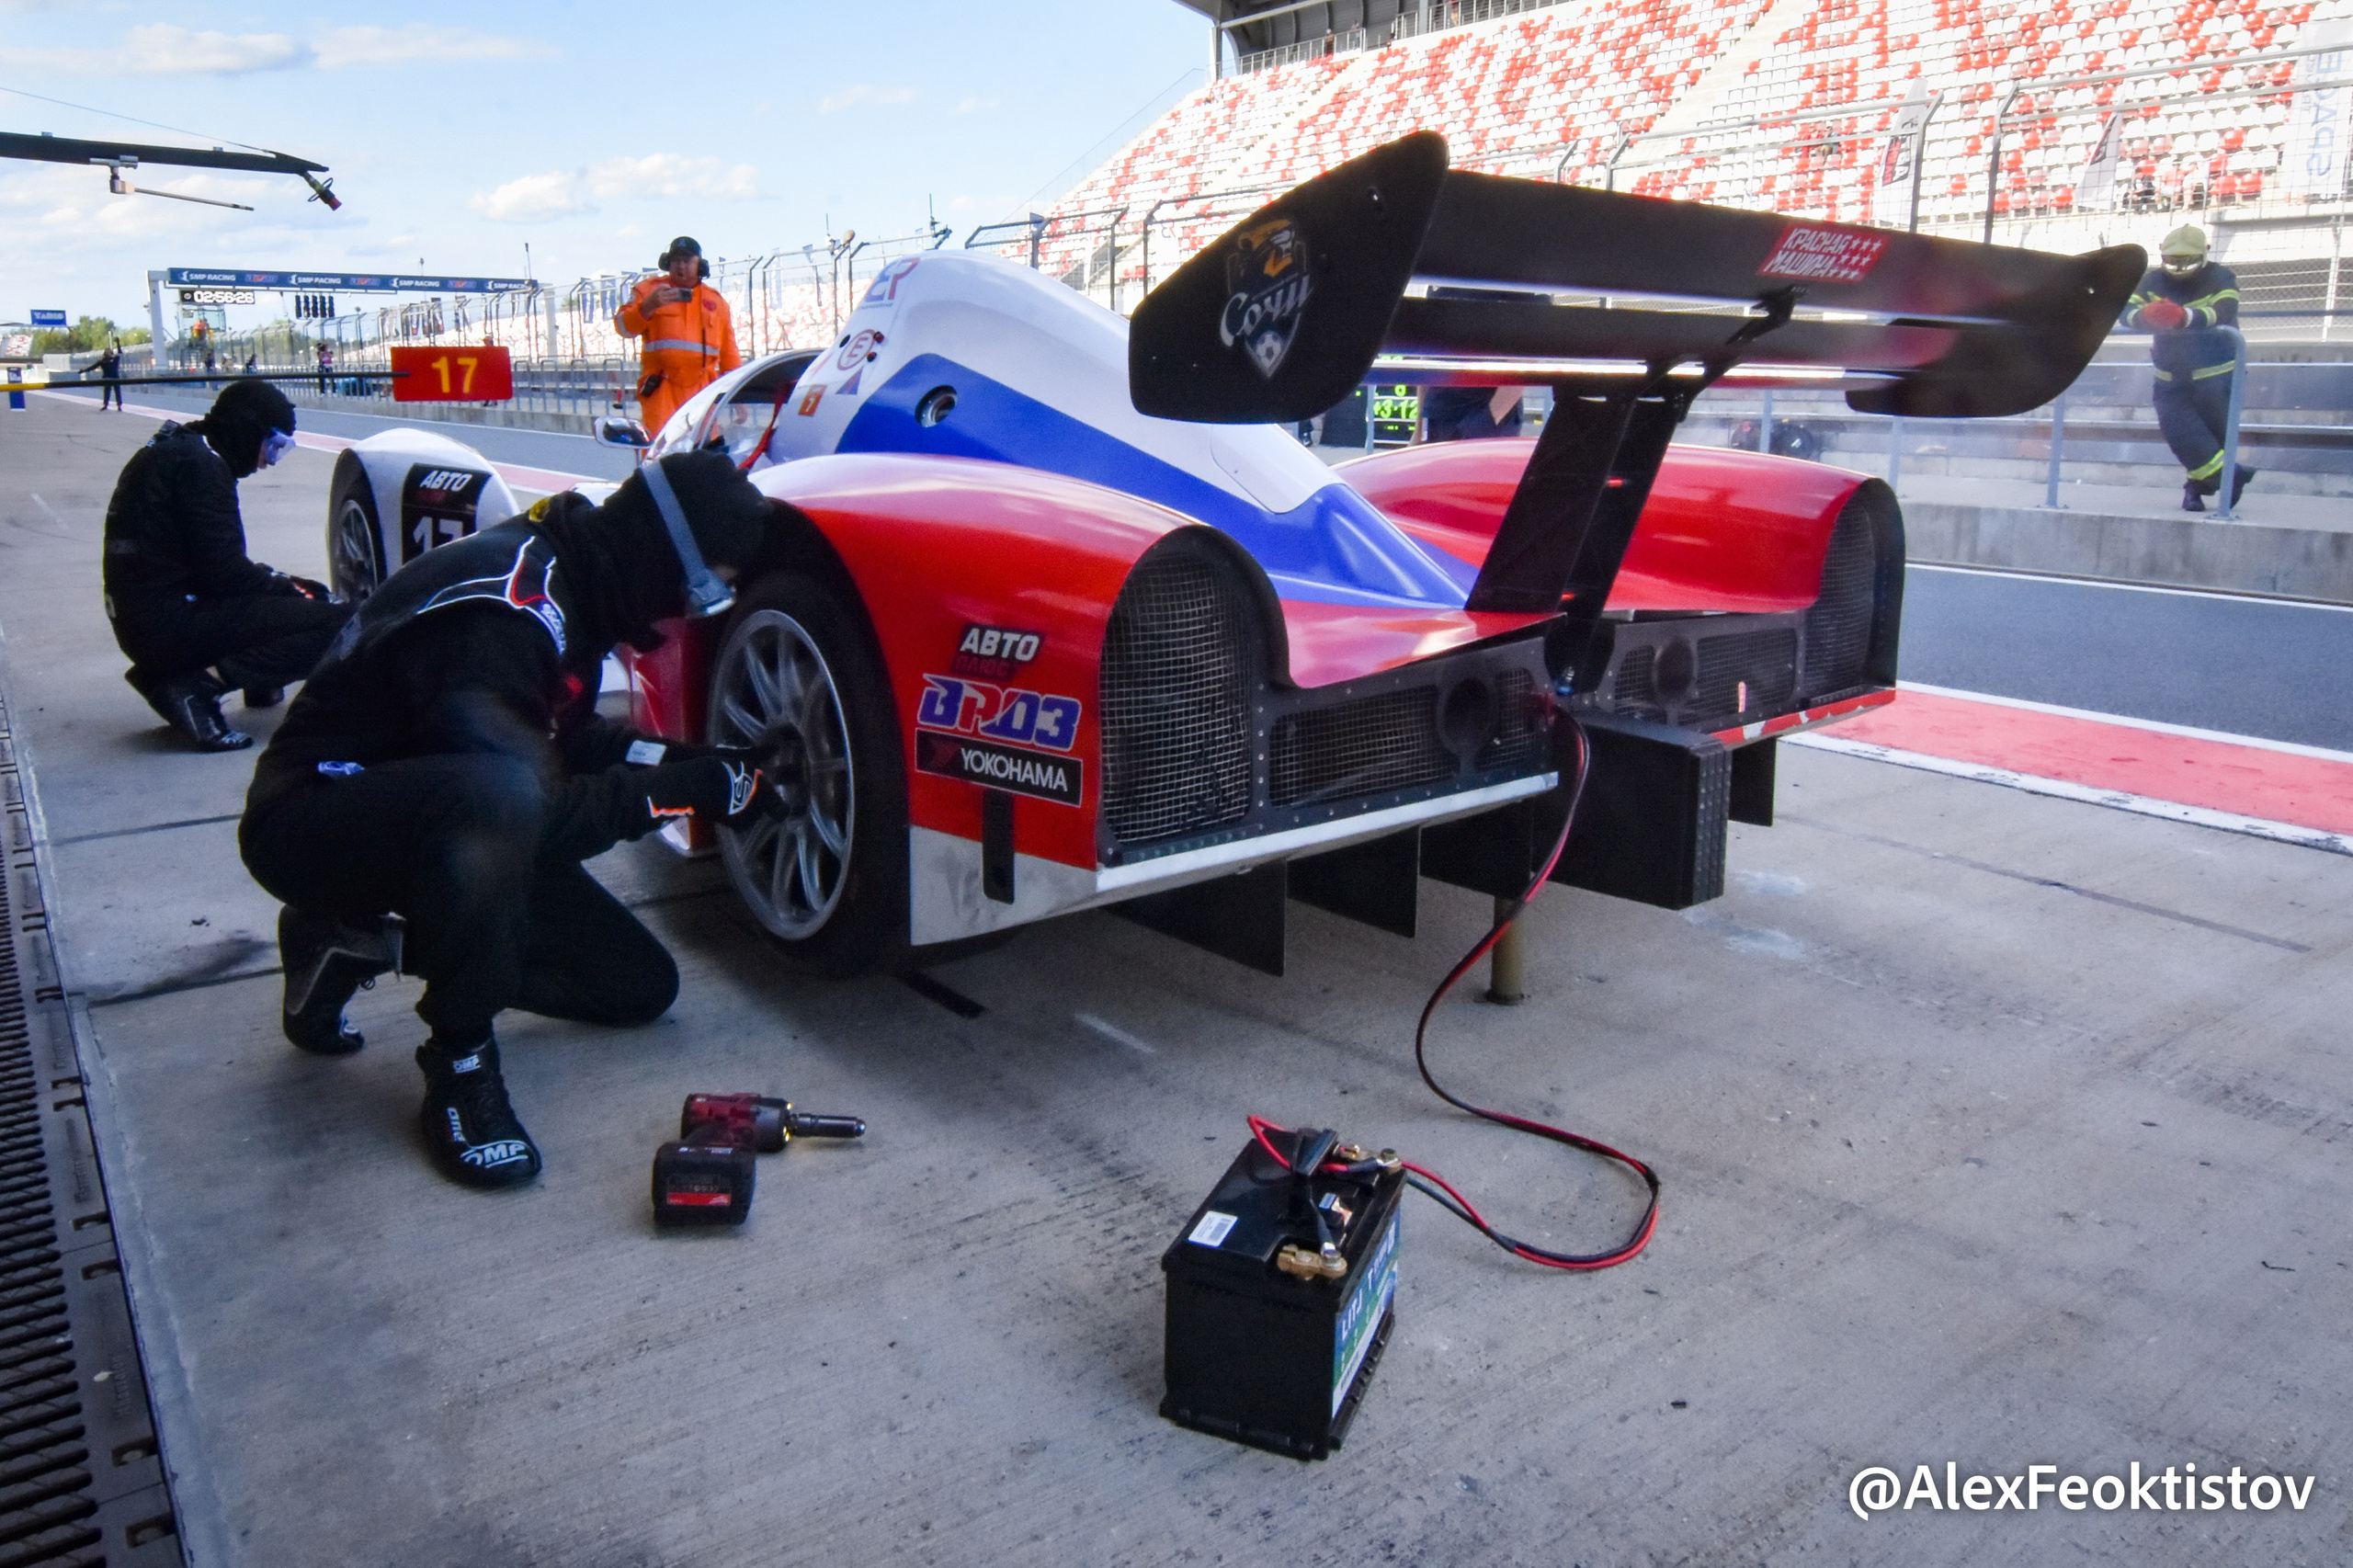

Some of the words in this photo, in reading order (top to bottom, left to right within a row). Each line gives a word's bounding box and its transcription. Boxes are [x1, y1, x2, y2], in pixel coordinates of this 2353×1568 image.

[1782, 228, 1853, 255] КРАСНАЯ
[1763, 250, 1836, 278] МАШИНА
[847, 336, 870, 358] E
[431, 356, 478, 393] 17
[419, 470, 472, 492] АВТО
[960, 627, 1040, 662] АВТО
[961, 747, 1068, 792] YOKOHAMA
